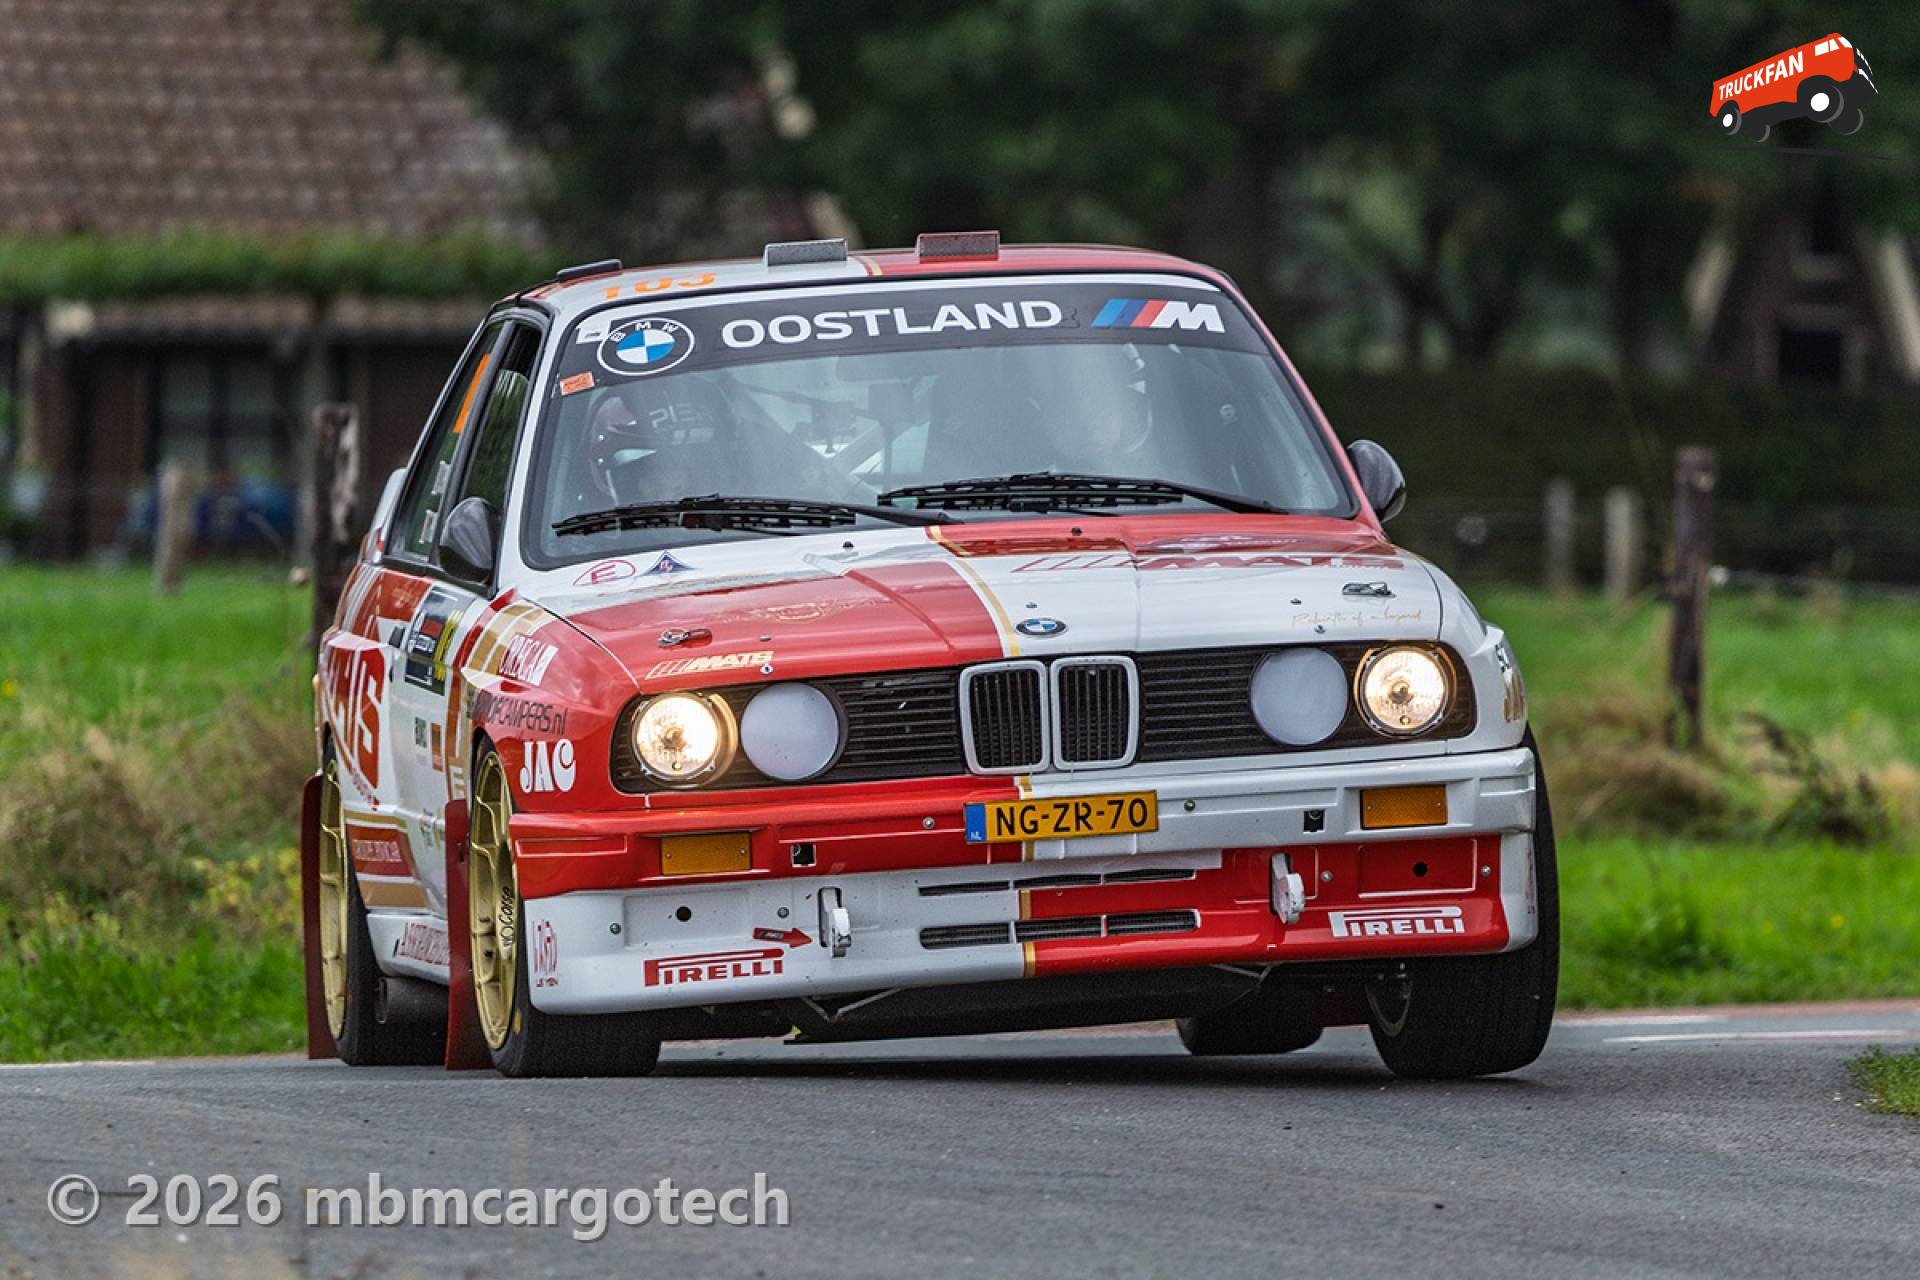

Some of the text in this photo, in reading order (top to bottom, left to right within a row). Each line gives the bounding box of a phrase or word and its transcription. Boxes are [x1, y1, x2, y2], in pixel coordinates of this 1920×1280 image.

[721, 299, 1063, 349] OOSTLAND
[519, 738, 577, 793] JAC
[995, 797, 1149, 837] NG-ZR-70
[1328, 906, 1465, 937] PIRELLI
[643, 948, 784, 987] PIRELLI
